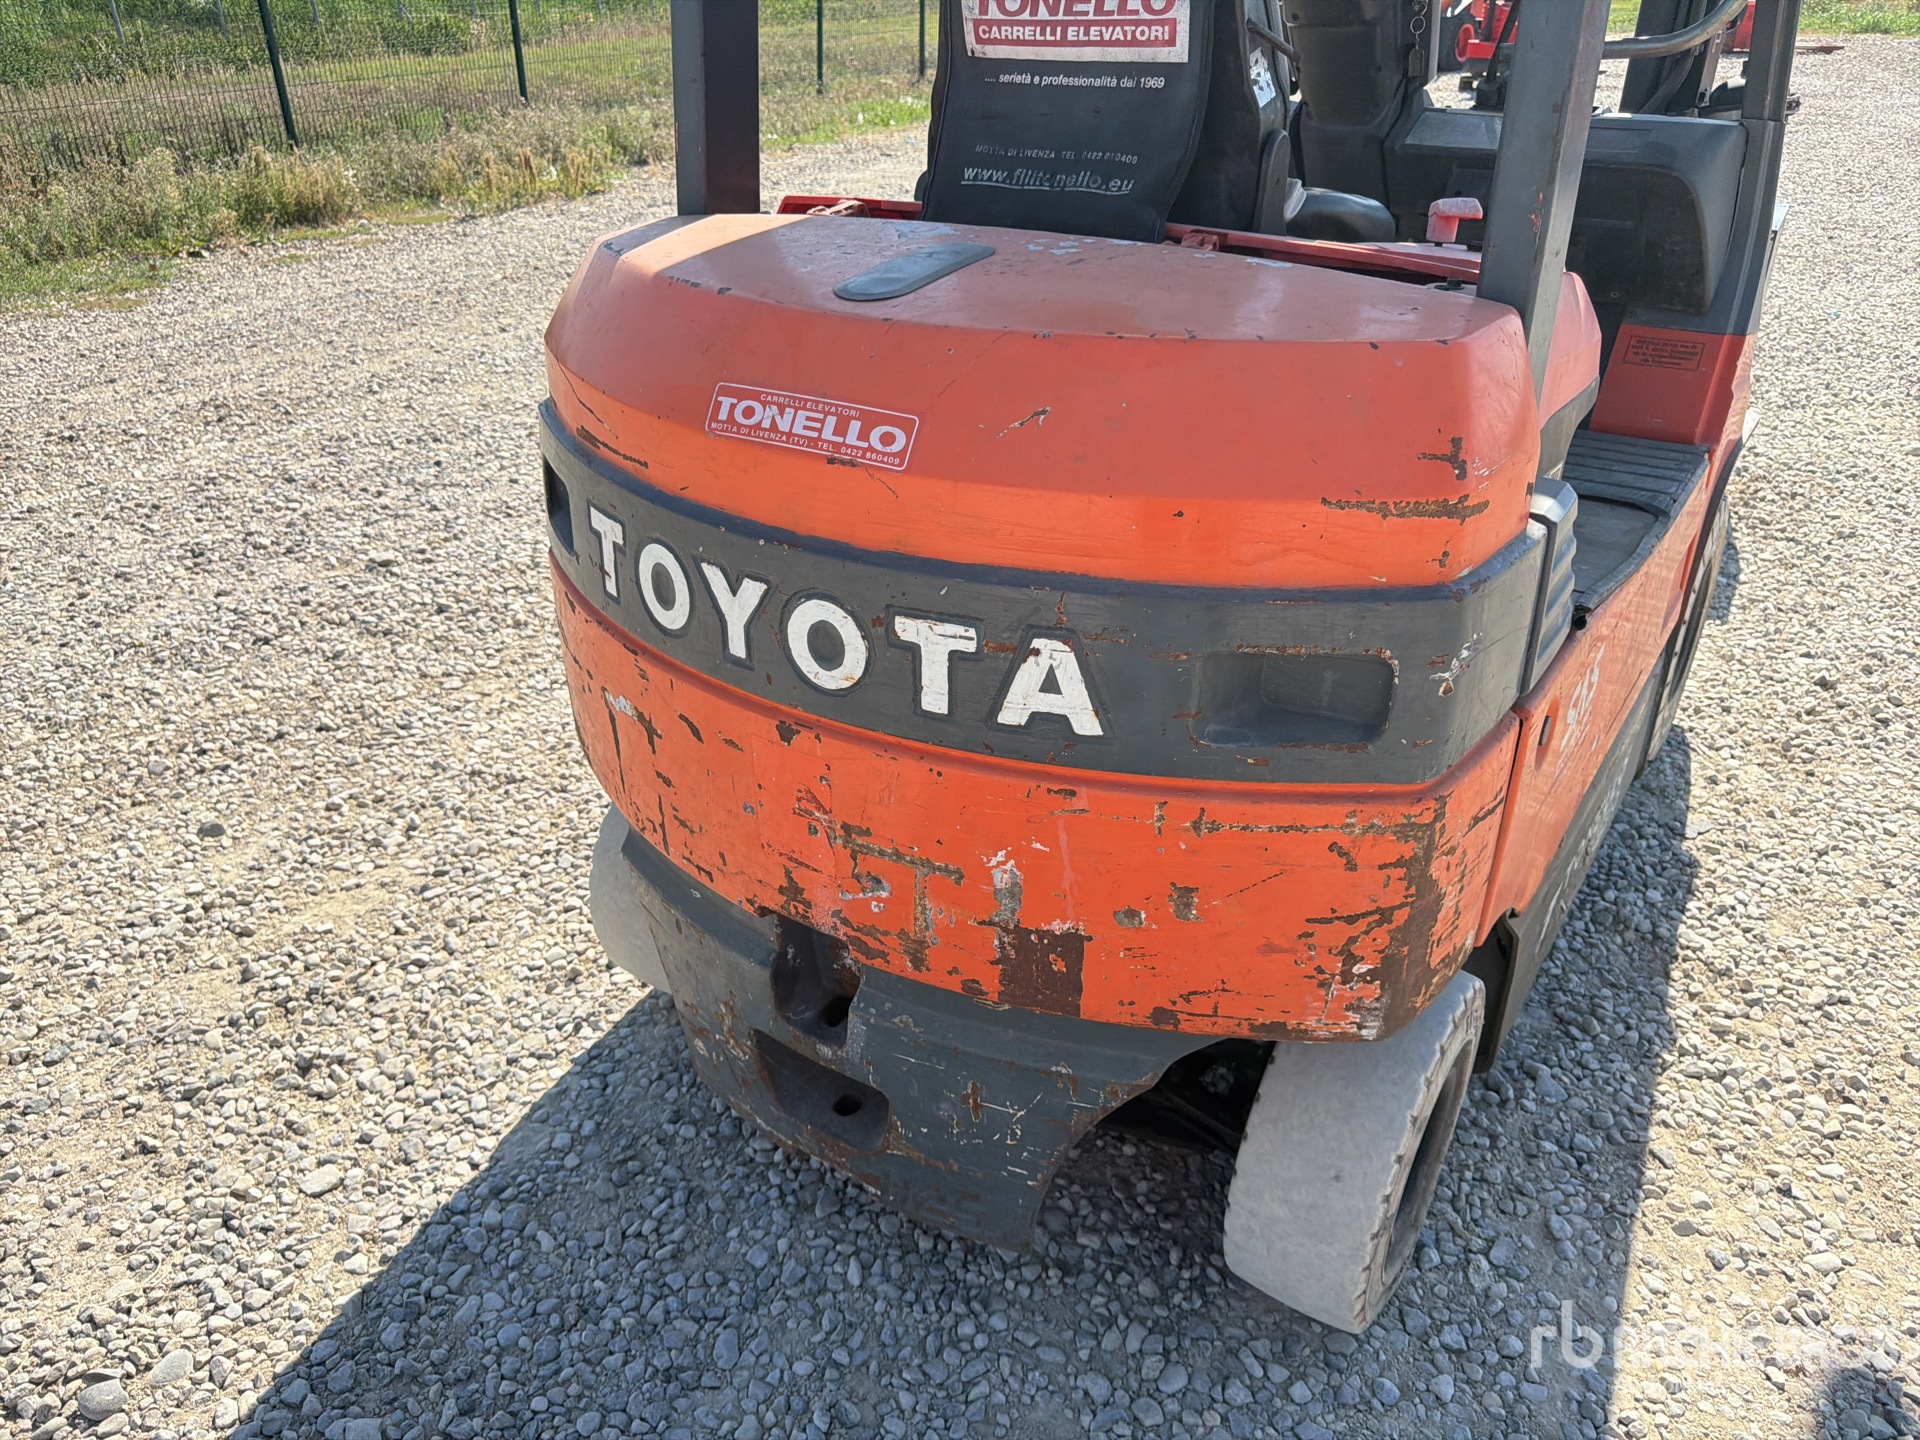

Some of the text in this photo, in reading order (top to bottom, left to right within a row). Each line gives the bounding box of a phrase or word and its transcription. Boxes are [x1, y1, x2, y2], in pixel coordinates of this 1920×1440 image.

[978, 25, 1169, 41] CARRELLI ELEVATORI
[998, 72, 1031, 84] serietà
[1033, 75, 1039, 84] e
[1041, 74, 1117, 87] professionalità
[1120, 76, 1137, 88] dal
[1139, 77, 1165, 89] 1969
[1007, 147, 1017, 156] DI
[1019, 148, 1055, 159] LIVENZA
[760, 393, 860, 417] CARRELLI ELEVATORI
[717, 396, 907, 453] TONELLO
[710, 422, 738, 433] MOTTA
[740, 427, 749, 435] DI
[751, 428, 787, 442] LIVENZA
[789, 436, 808, 447] (TV)
[817, 441, 837, 452] TEL.
[840, 446, 862, 457] 0422
[865, 451, 900, 465] 860409
[589, 504, 1105, 736] TOYOTA
